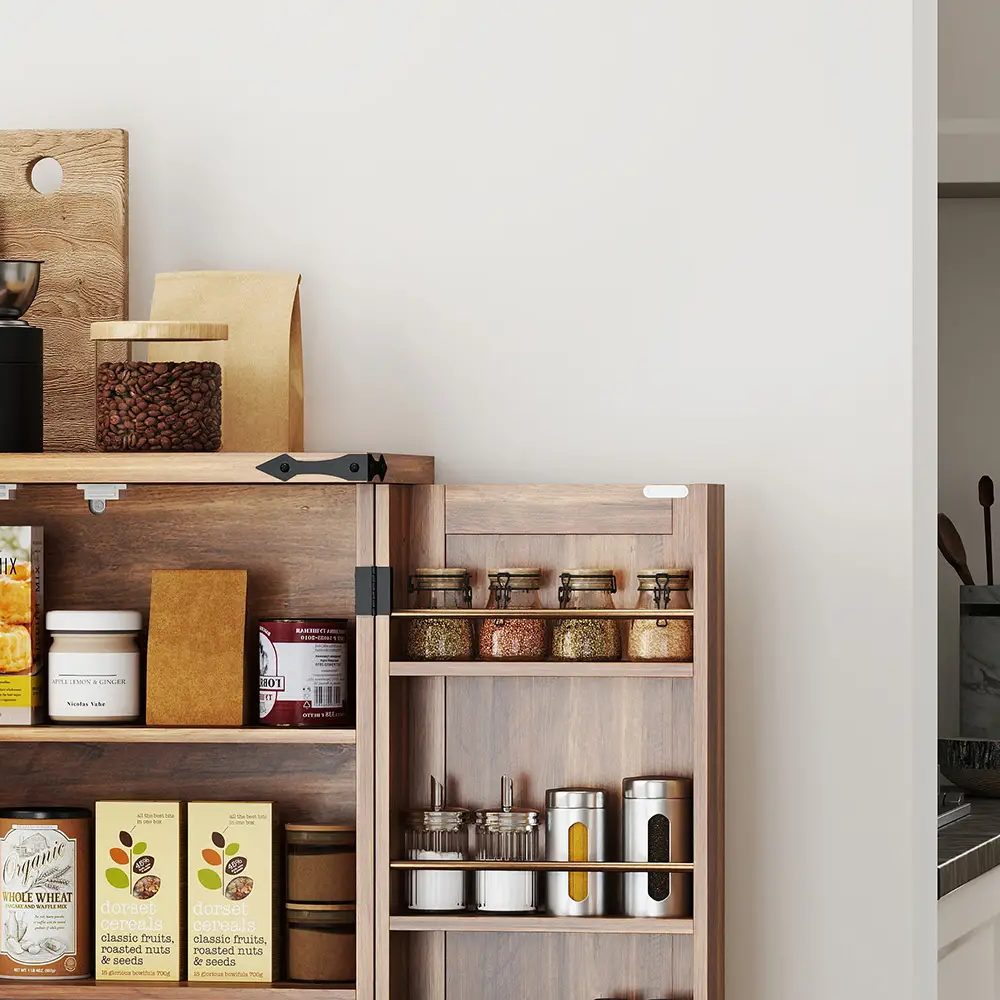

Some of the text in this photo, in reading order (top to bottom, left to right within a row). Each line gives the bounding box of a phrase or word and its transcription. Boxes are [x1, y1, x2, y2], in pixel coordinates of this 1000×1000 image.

[2, 840, 66, 886] Organic
[2, 892, 73, 903] WHOLE WHEAT
[100, 901, 157, 915] dorset
[193, 902, 249, 916] dorset
[100, 918, 163, 931] cereals
[193, 918, 256, 932] cereals
[101, 933, 175, 944] classic fruits,
[193, 934, 267, 945] classic fruits,
[101, 944, 170, 954] roasted nuts
[193, 946, 264, 956] roasted nuts
[101, 956, 144, 965] & seeds
[193, 957, 236, 966] & seeds
